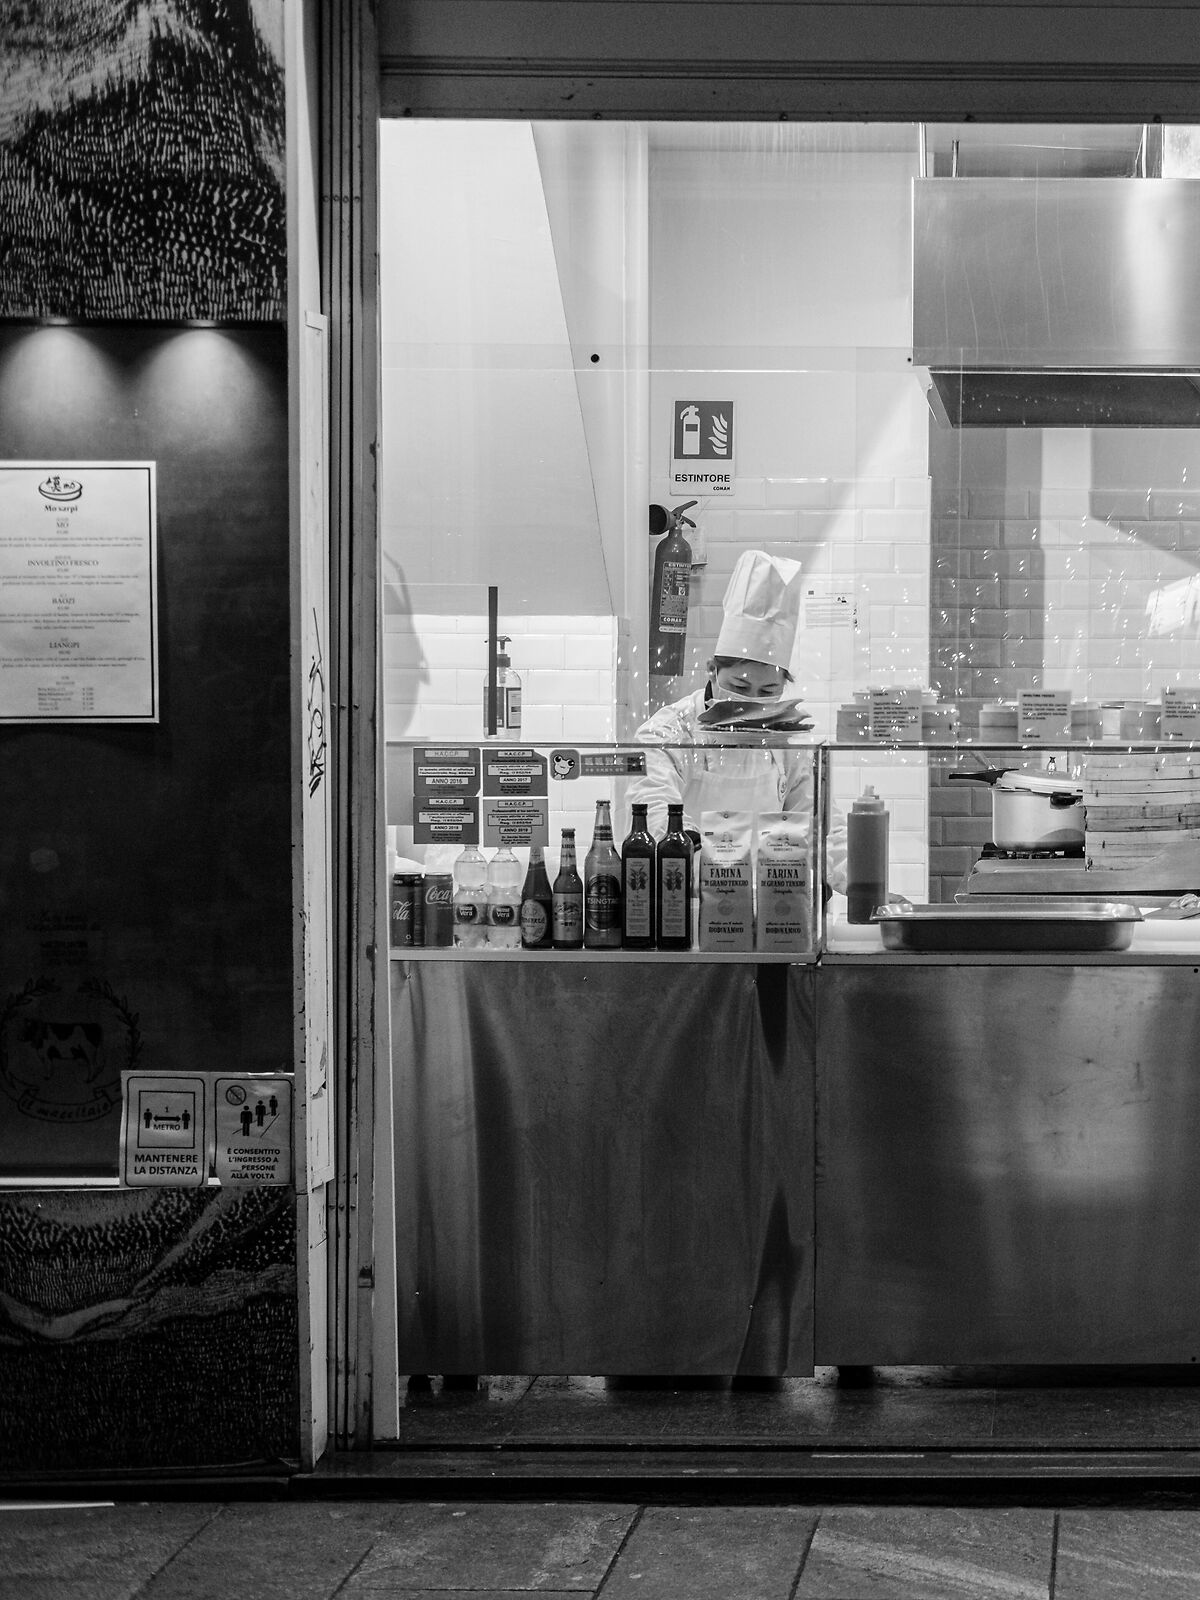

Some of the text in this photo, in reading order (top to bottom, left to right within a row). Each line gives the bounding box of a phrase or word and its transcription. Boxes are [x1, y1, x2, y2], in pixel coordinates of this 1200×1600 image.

[675, 474, 731, 483] ESTINTORE
[710, 868, 742, 879] FARINA
[767, 868, 799, 879] FARINA
[587, 897, 620, 905] TSINGTA
[134, 1154, 199, 1163] MANTENERE
[134, 1166, 198, 1175] LA DISTANZA
